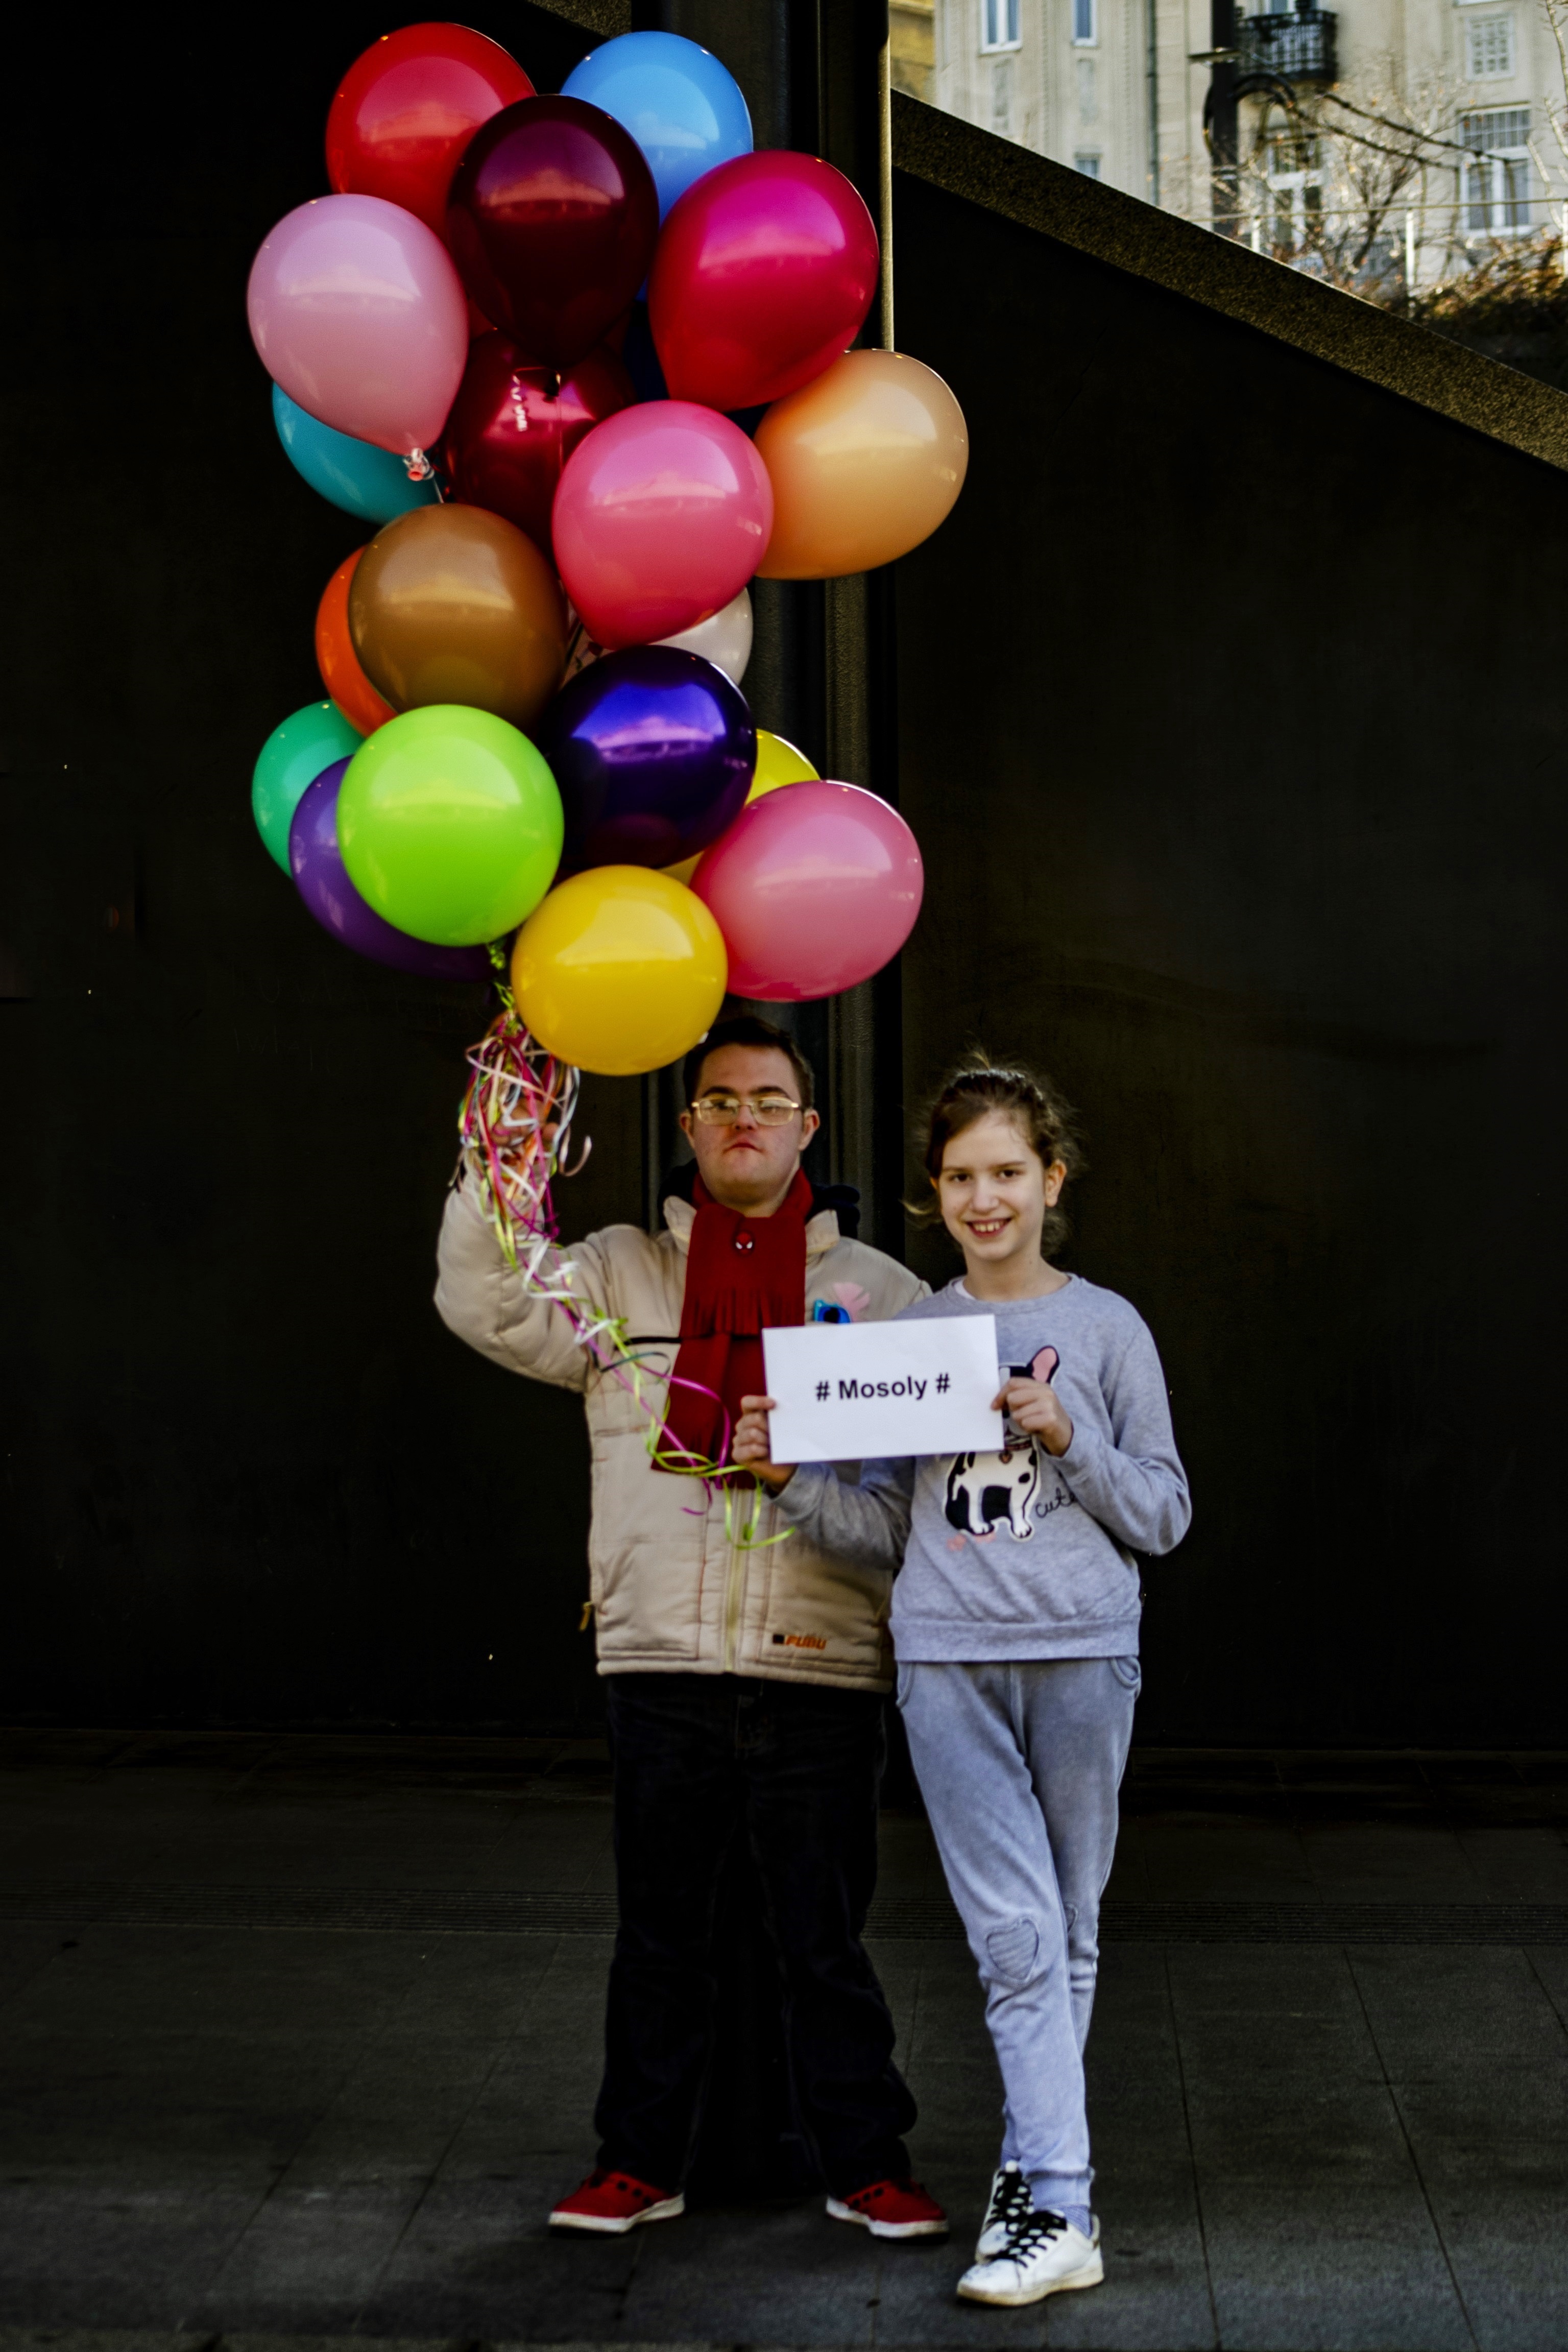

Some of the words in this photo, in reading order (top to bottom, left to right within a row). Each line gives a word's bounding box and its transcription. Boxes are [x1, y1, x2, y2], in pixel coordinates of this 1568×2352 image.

[815, 1381, 830, 1401] #
[838, 1376, 927, 1401] Mosoly
[935, 1373, 951, 1394] #
